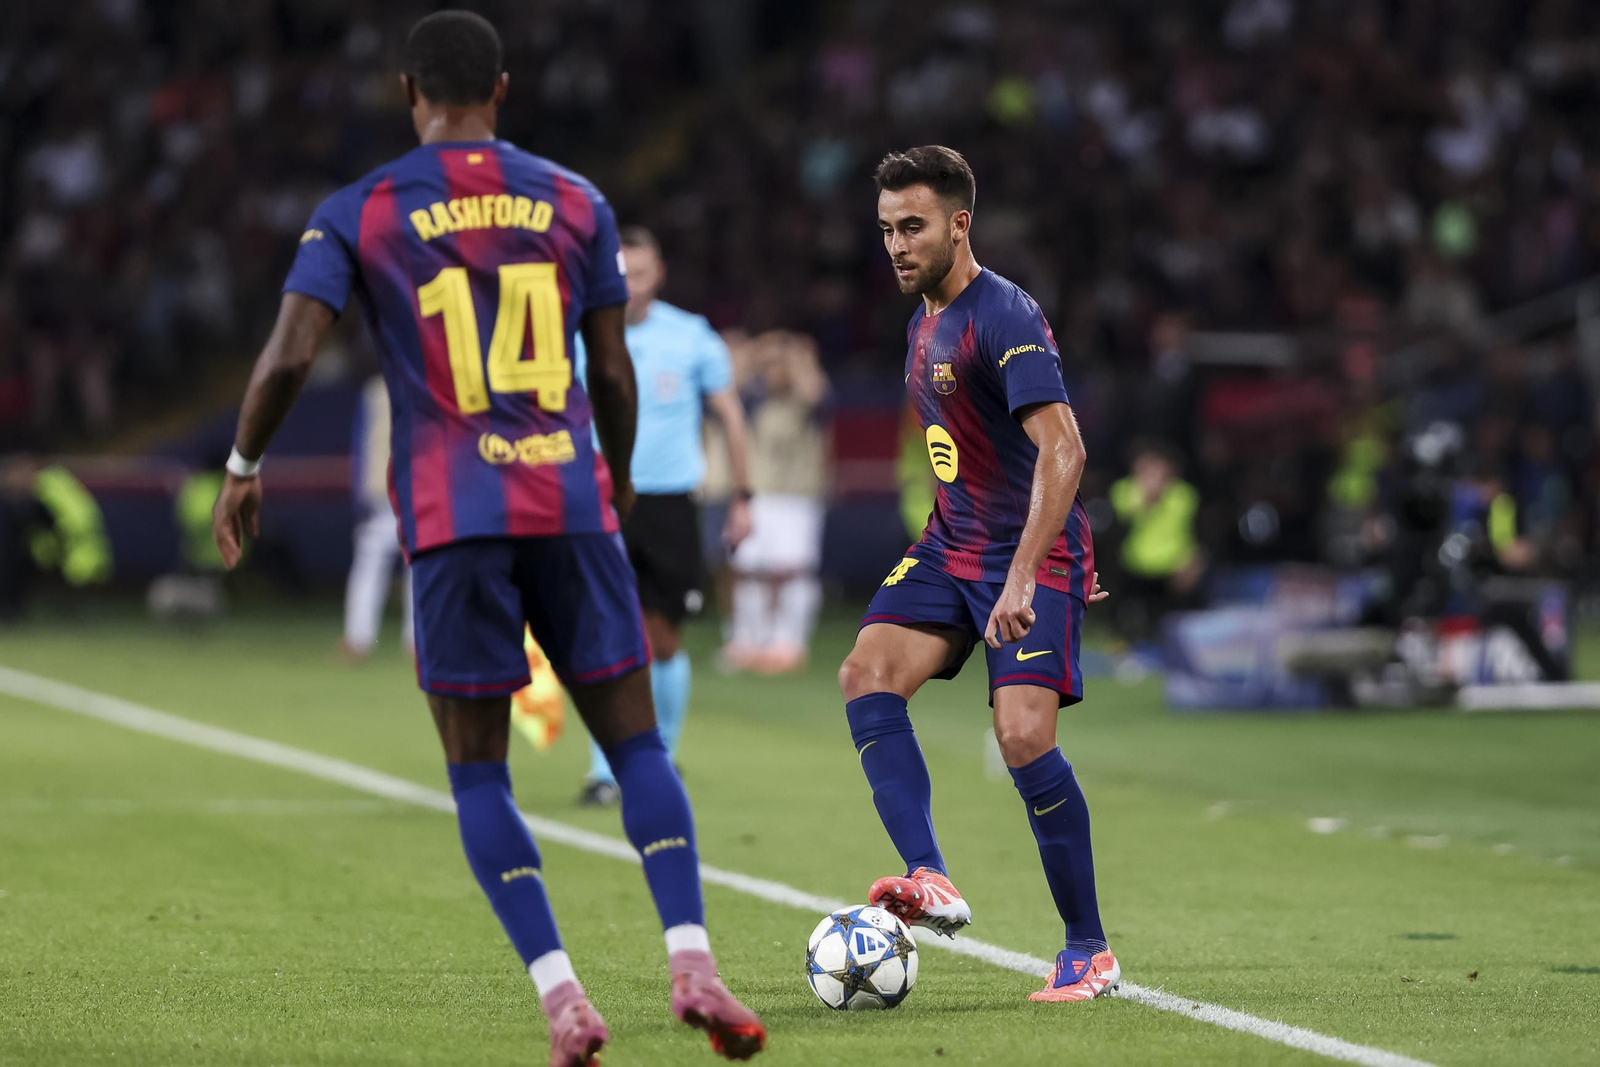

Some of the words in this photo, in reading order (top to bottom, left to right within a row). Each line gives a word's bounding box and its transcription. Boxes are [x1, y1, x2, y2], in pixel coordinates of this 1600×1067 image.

[410, 194, 554, 242] RASHFORD
[418, 262, 571, 415] 14
[998, 344, 1037, 368] AMBILIGHT
